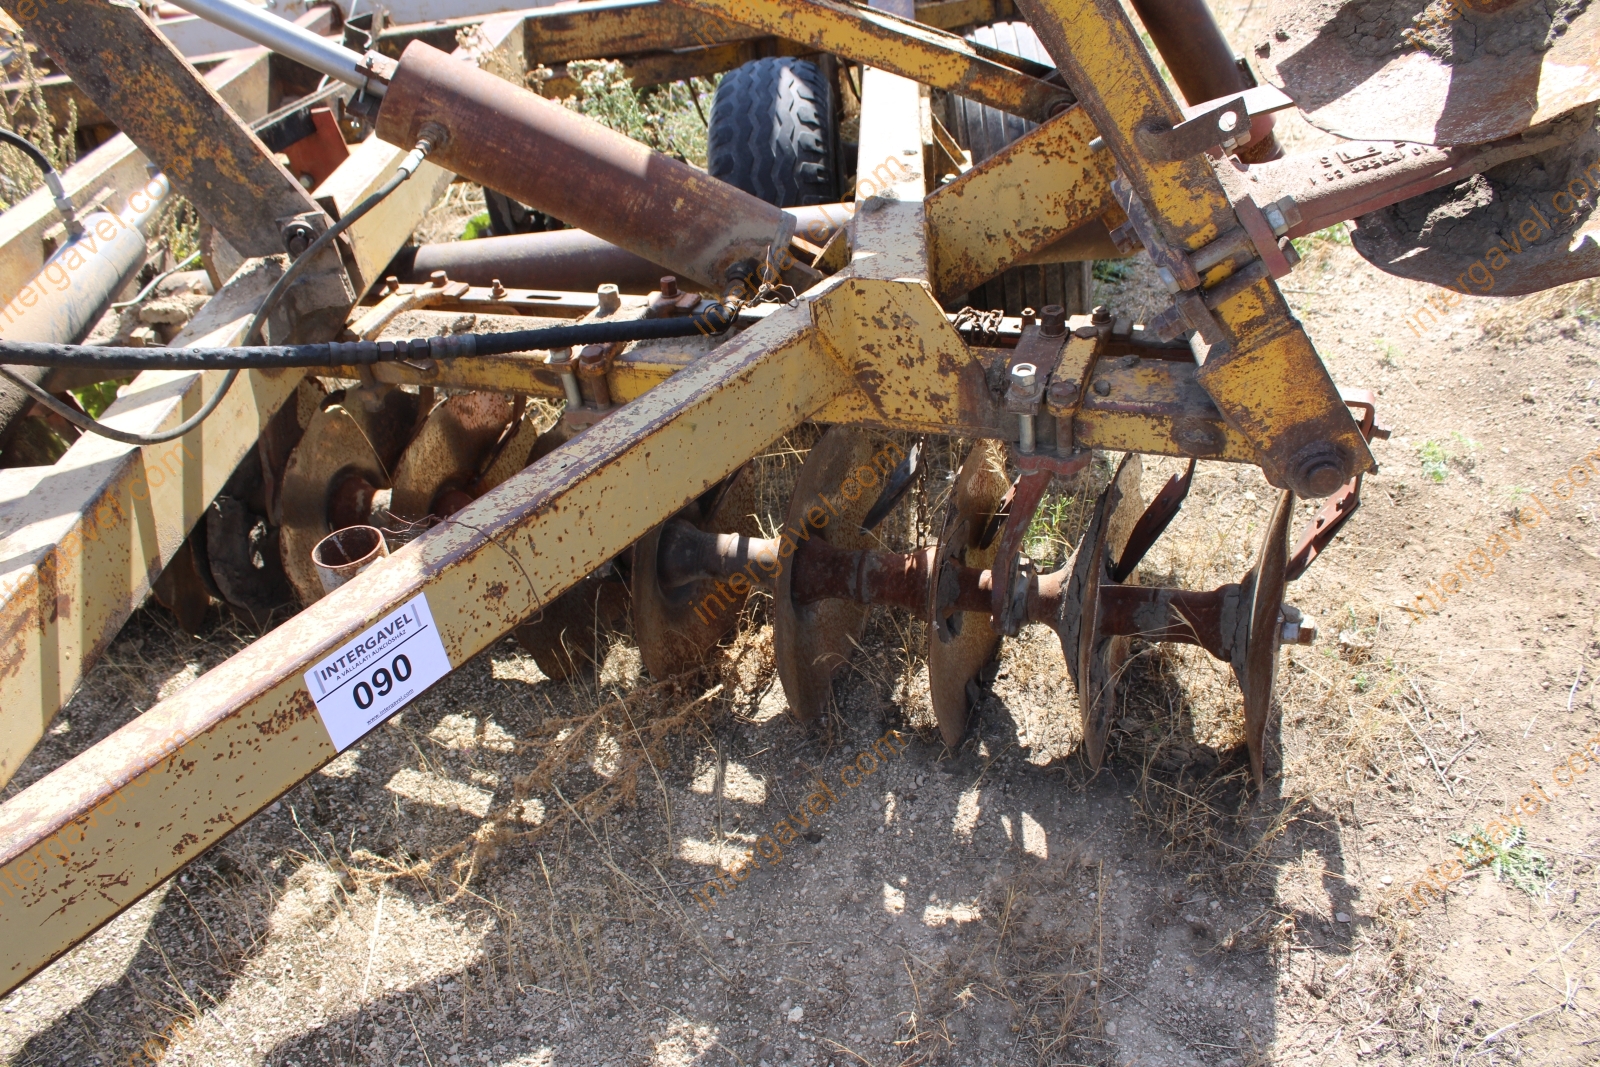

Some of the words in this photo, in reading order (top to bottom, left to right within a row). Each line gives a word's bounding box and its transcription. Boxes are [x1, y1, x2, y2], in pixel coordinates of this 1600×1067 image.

[320, 613, 414, 681] INTERGAVEL
[352, 653, 413, 710] 090
[366, 688, 414, 725] www.intergavel.com
